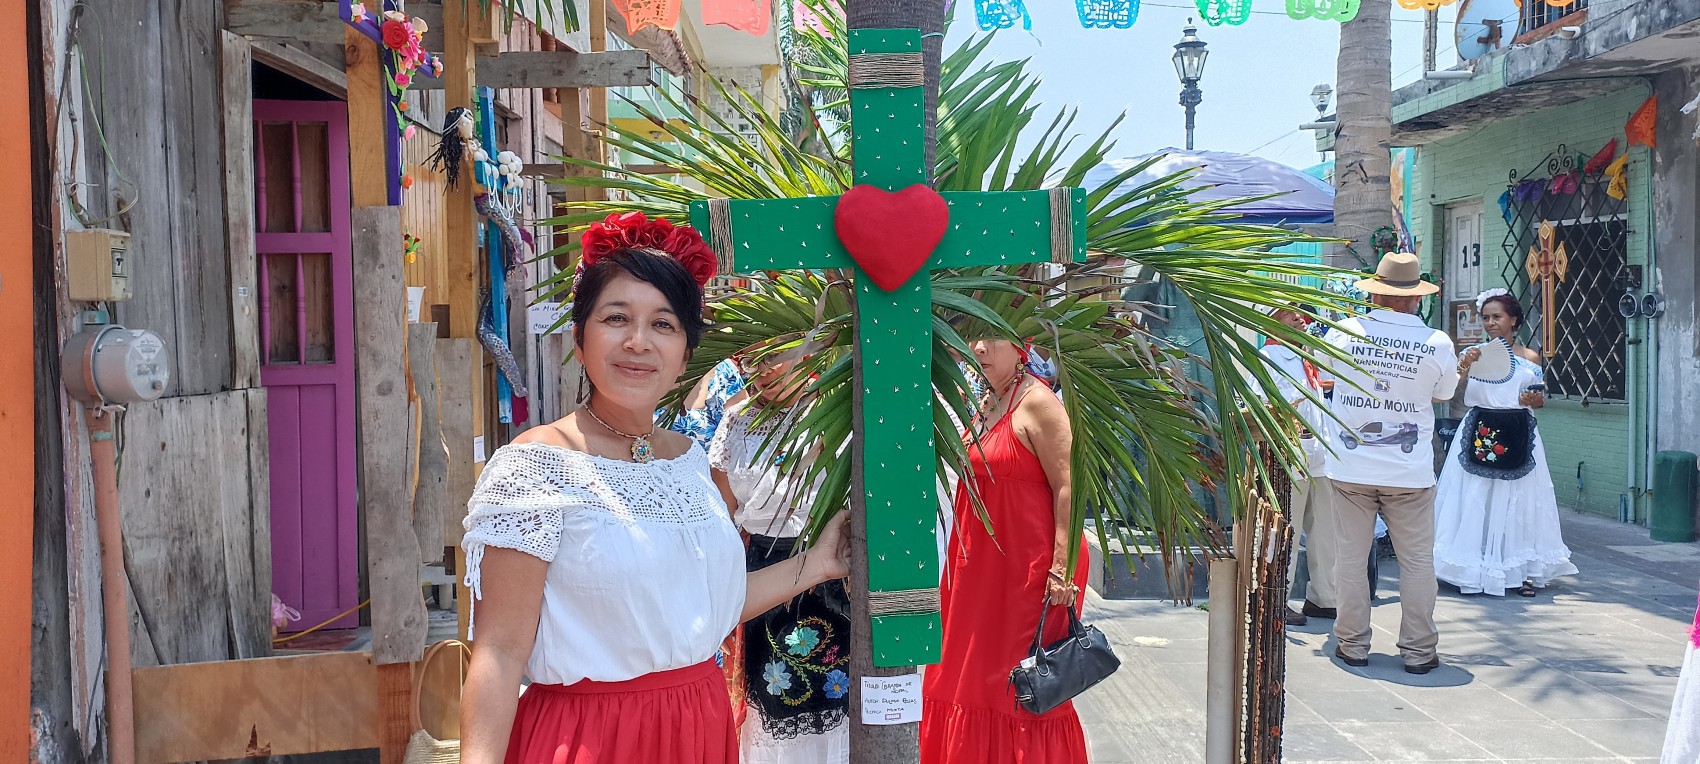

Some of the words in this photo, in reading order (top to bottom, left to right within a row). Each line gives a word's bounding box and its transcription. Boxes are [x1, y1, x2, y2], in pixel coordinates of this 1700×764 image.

[1462, 243, 1481, 268] 13
[1351, 346, 1424, 365] INTERNET
[1413, 342, 1436, 356] POR
[1369, 370, 1400, 378] VERACRUZ
[1340, 394, 1381, 409] UNIDAD
[1384, 399, 1420, 413] MÓVIL
